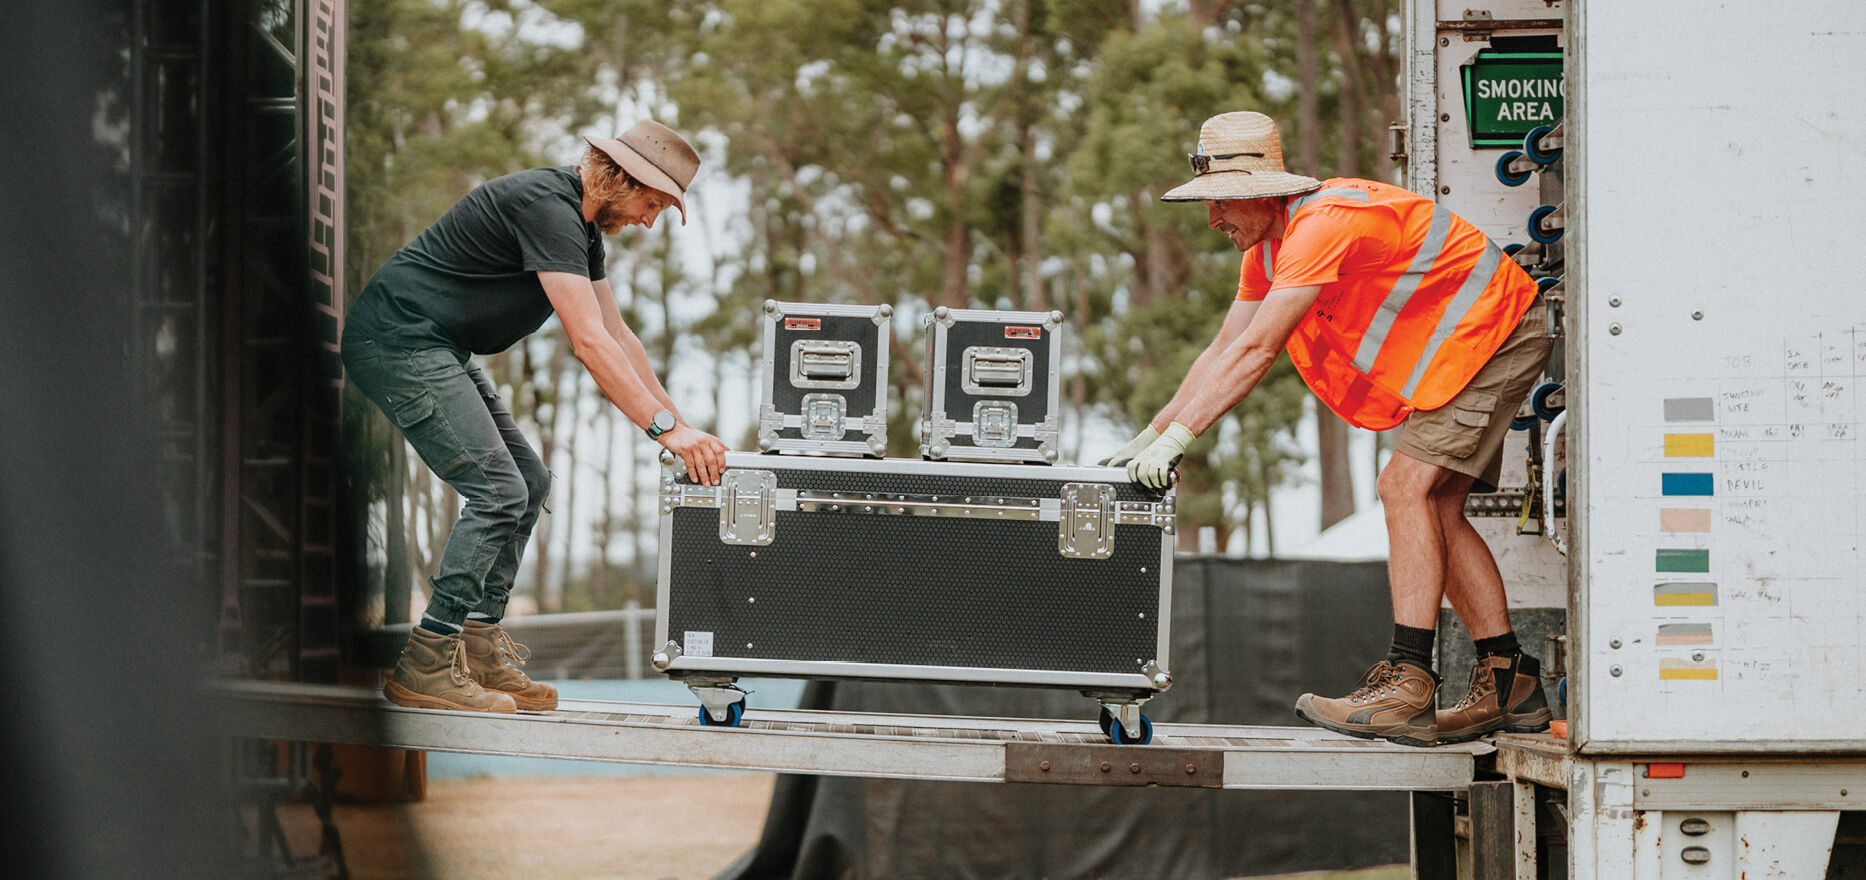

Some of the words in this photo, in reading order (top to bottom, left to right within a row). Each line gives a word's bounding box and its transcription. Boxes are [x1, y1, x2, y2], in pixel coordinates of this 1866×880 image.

[1496, 101, 1555, 121] AREA
[1726, 402, 1751, 414] SITE
[1727, 479, 1766, 492] DEVIL
